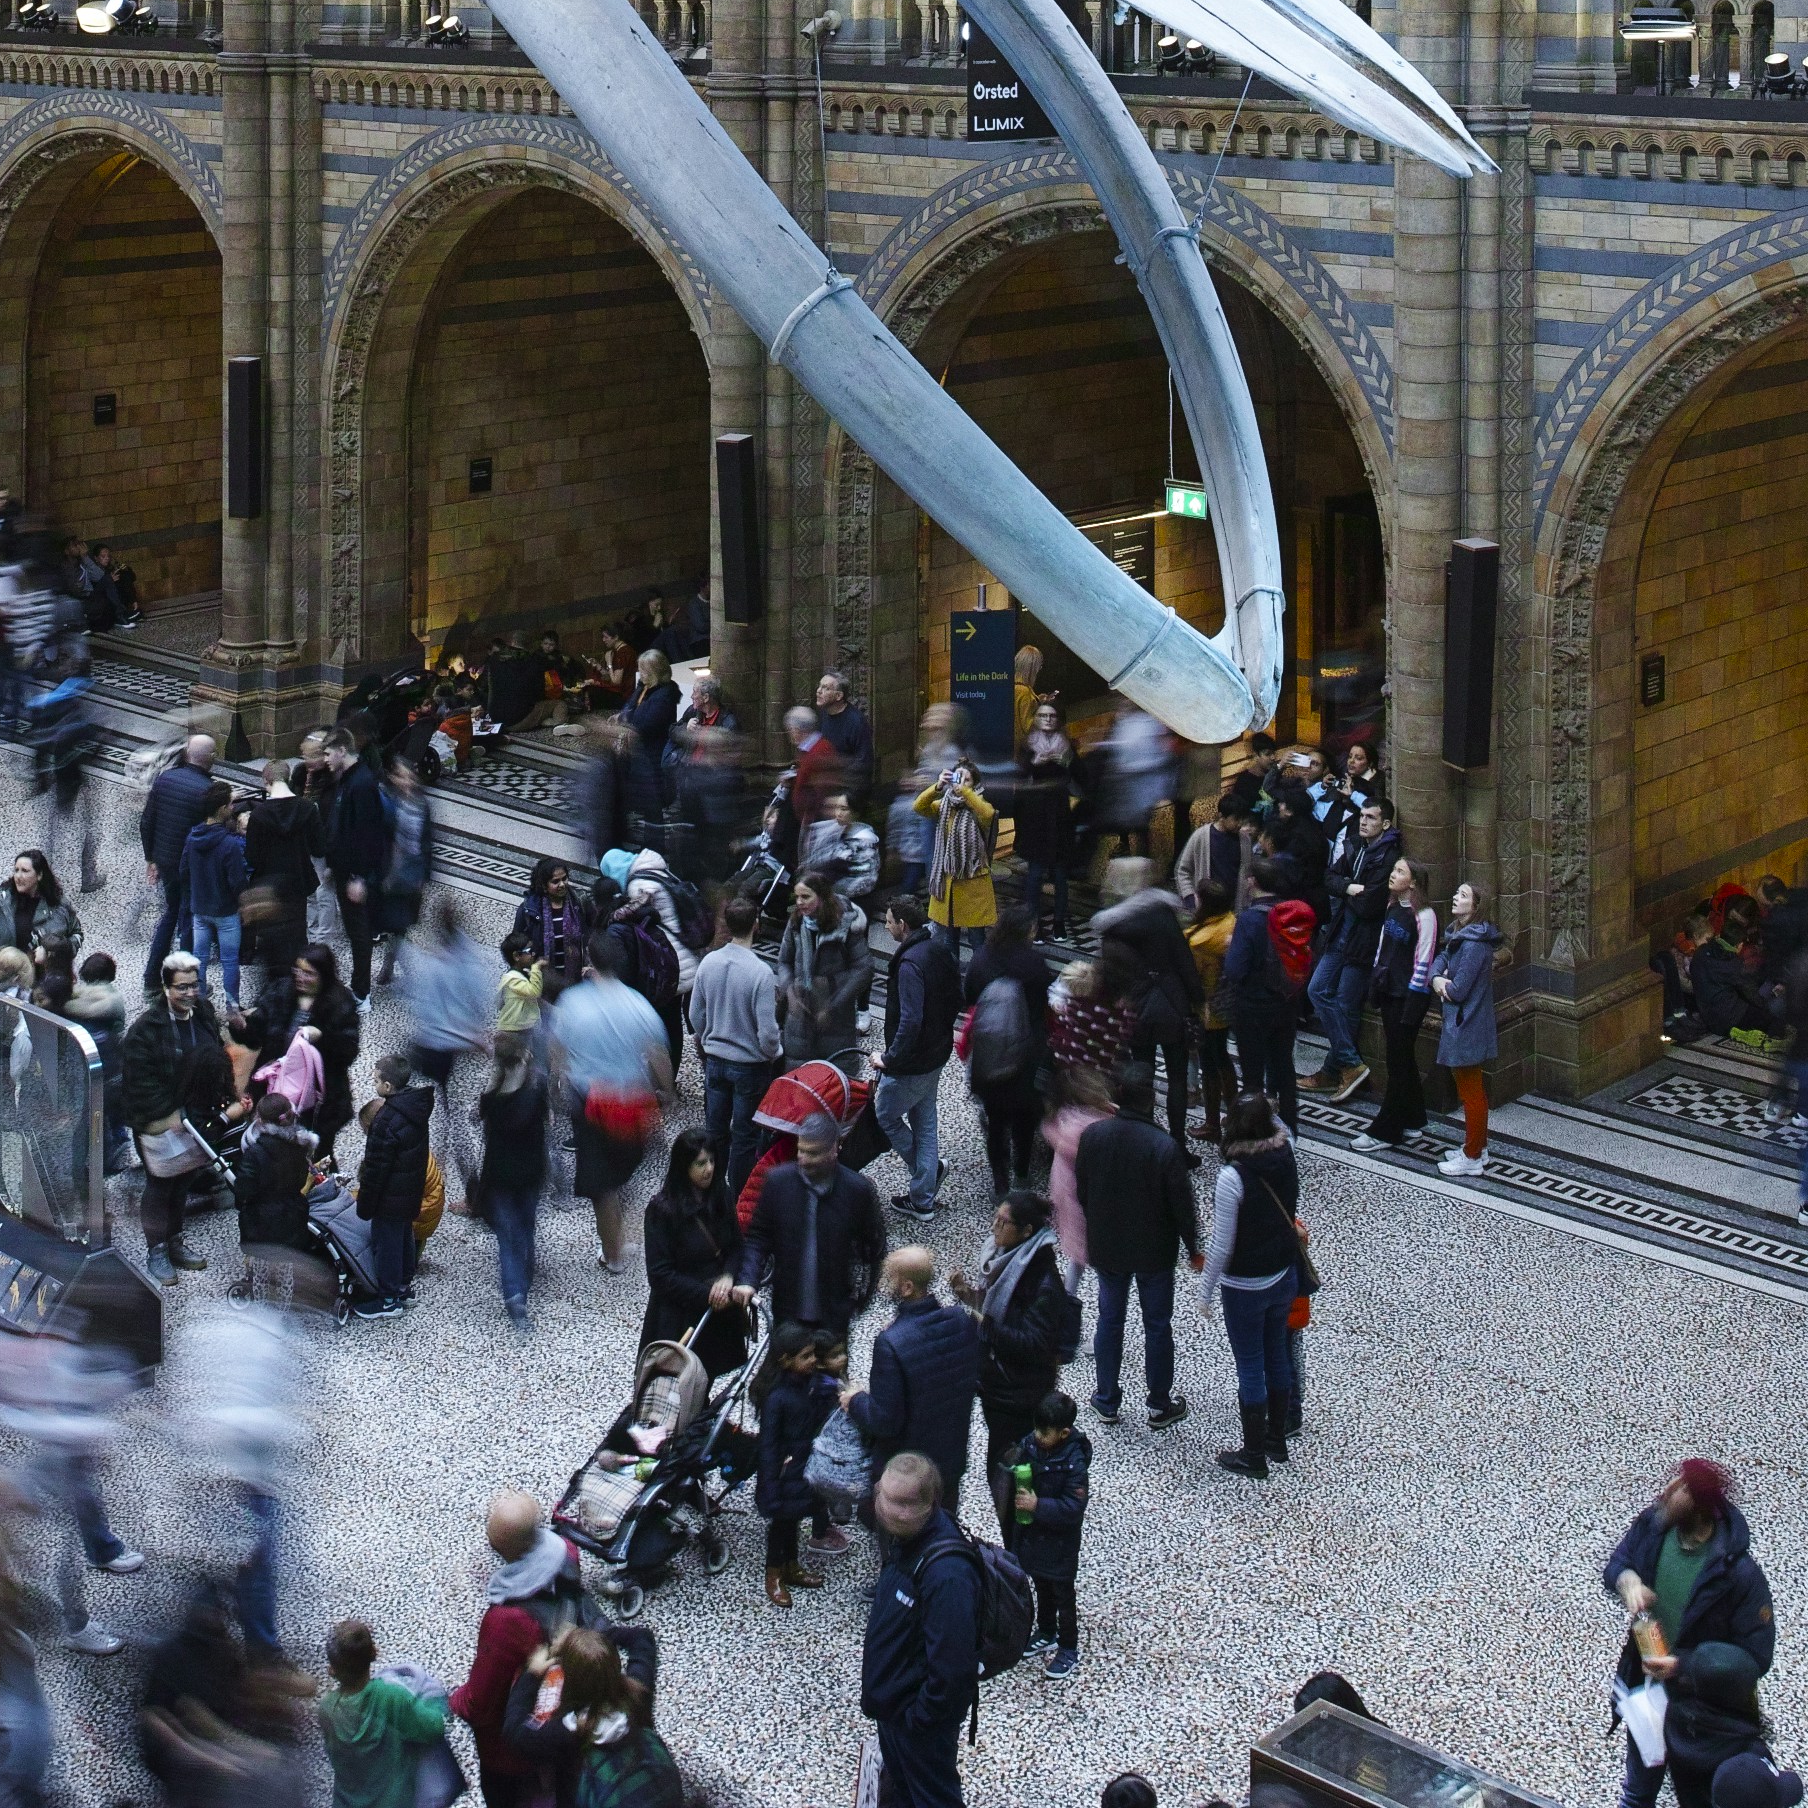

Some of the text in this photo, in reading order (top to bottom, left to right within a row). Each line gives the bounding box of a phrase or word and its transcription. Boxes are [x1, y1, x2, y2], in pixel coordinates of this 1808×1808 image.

[973, 116, 1025, 132] LUMIX
[955, 671, 1009, 682] Life in the Dark
[955, 690, 986, 700] Visit today
